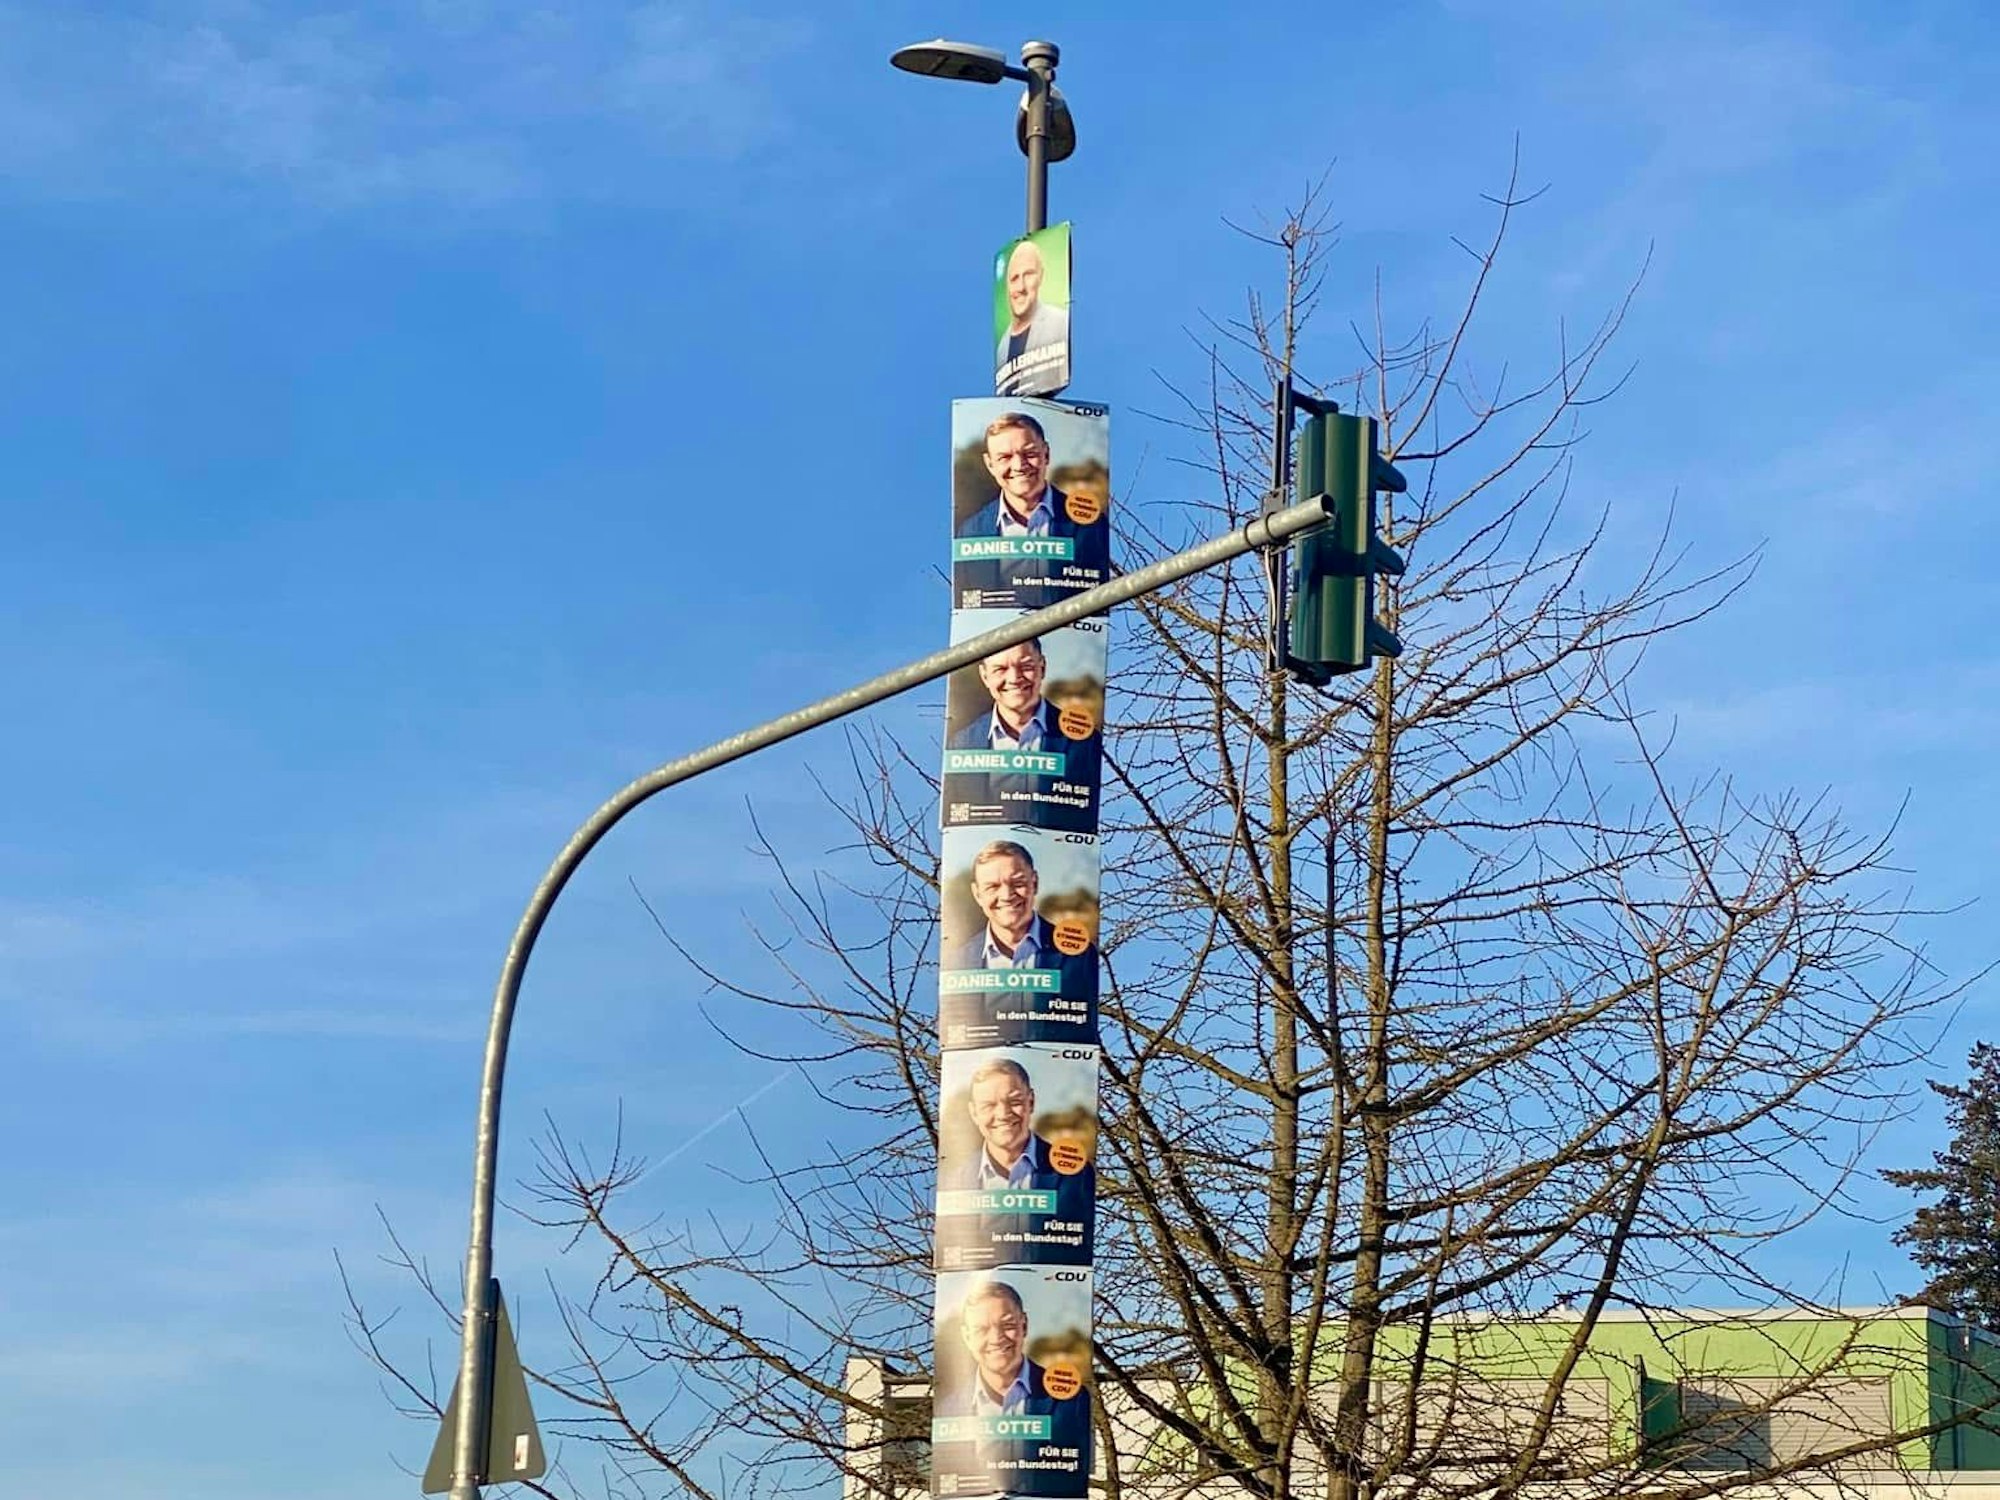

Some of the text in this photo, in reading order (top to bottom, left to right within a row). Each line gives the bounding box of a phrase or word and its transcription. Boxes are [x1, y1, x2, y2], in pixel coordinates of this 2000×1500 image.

[1074, 405, 1104, 417] CDU
[960, 541, 1065, 556] DANIEL OTTE
[1063, 565, 1099, 578] FÜR SIE
[1012, 576, 1022, 585] in
[1024, 576, 1042, 585] den
[1073, 621, 1102, 633] CDU
[951, 755, 1056, 771] DANIEL OTTE
[1052, 781, 1090, 795] FÜR SIE
[1001, 791, 1088, 808] in den Bundestag!
[1065, 834, 1094, 845] CDU
[946, 974, 1051, 988] DANIEL OTTE
[1048, 998, 1087, 1011] FÜR SIE
[996, 1010, 1086, 1024] in den Bundestag!
[1062, 1049, 1093, 1060] CDU
[1003, 1194, 1047, 1208] OTTE
[1044, 1220, 1083, 1232] FÜR SIE
[992, 1232, 1082, 1245] in den Bundestag!
[1055, 1271, 1087, 1282] CDU
[997, 1421, 1041, 1434] OTTE
[1039, 1445, 1079, 1457] FÜR SIE
[998, 1460, 1016, 1469] den
[1018, 1459, 1078, 1472] Bundestag!
